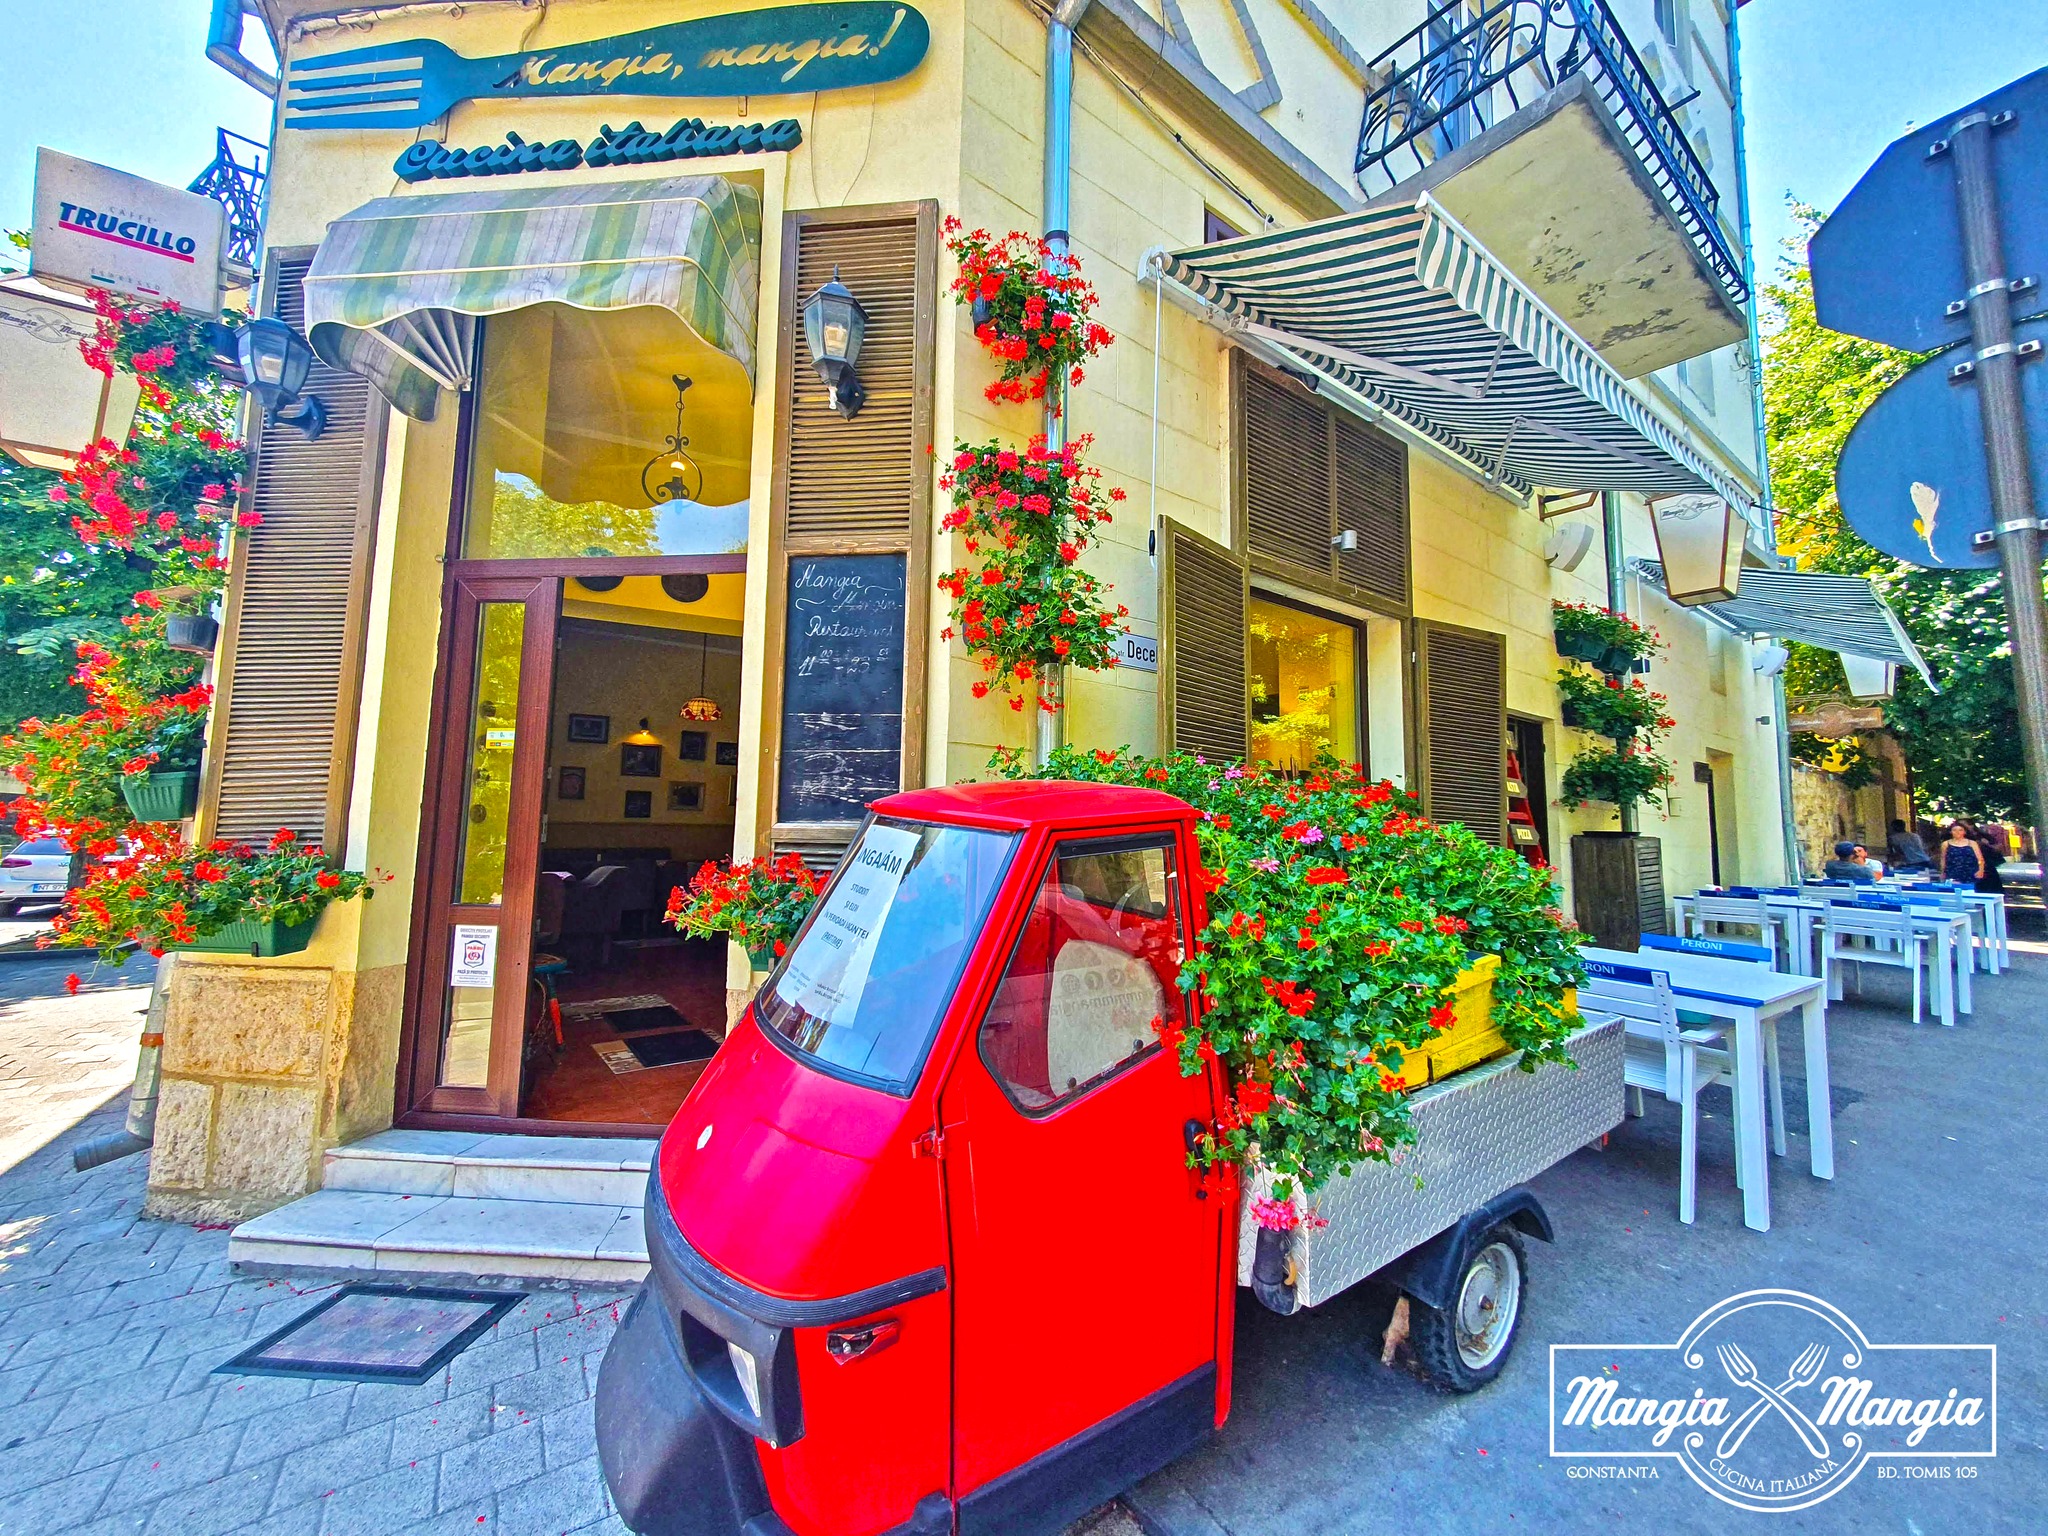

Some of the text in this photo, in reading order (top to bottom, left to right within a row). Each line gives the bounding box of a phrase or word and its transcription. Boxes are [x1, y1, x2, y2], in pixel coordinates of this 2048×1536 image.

[699, 7, 906, 82] mangia!
[393, 117, 803, 183] Cucina italiana
[60, 202, 196, 254] TRUCILLO
[795, 564, 866, 600] Mangia
[1127, 639, 1158, 664] Dece
[1681, 938, 1723, 951] PERONI
[1578, 961, 1616, 975] ERONI
